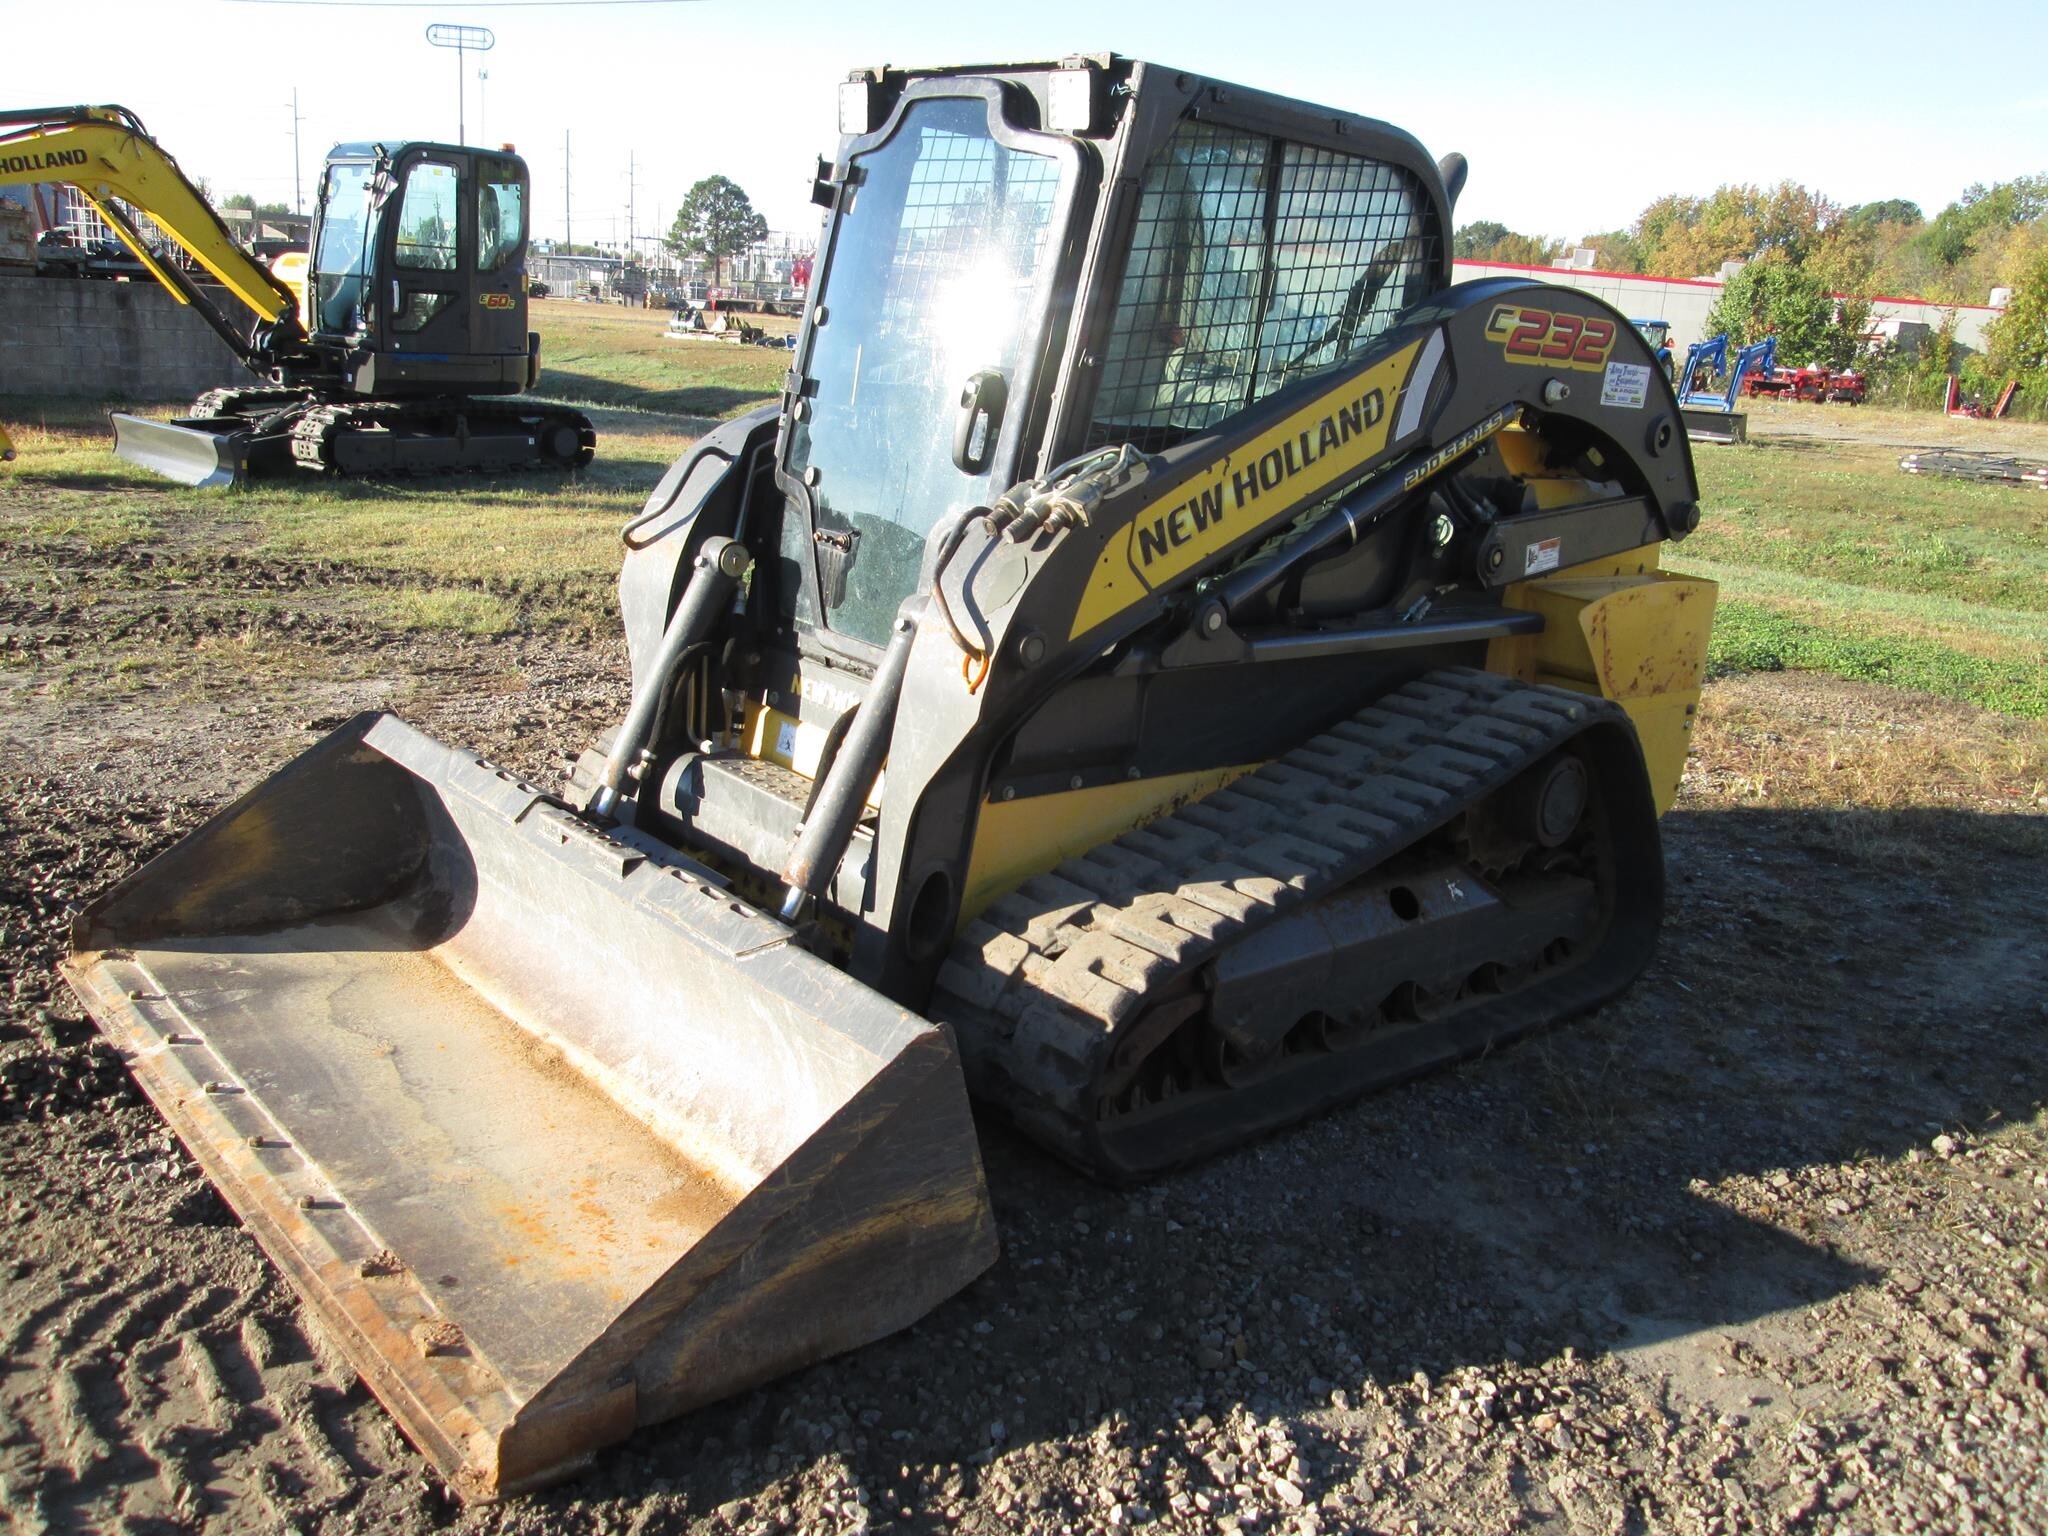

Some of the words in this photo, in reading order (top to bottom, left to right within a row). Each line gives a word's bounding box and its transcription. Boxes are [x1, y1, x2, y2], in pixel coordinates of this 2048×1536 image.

[1486, 305, 1616, 369] C232
[1137, 480, 1223, 567] NEW
[1231, 387, 1385, 509] HOLLAND
[1404, 451, 1443, 491] 200
[1443, 411, 1503, 463] SERIES
